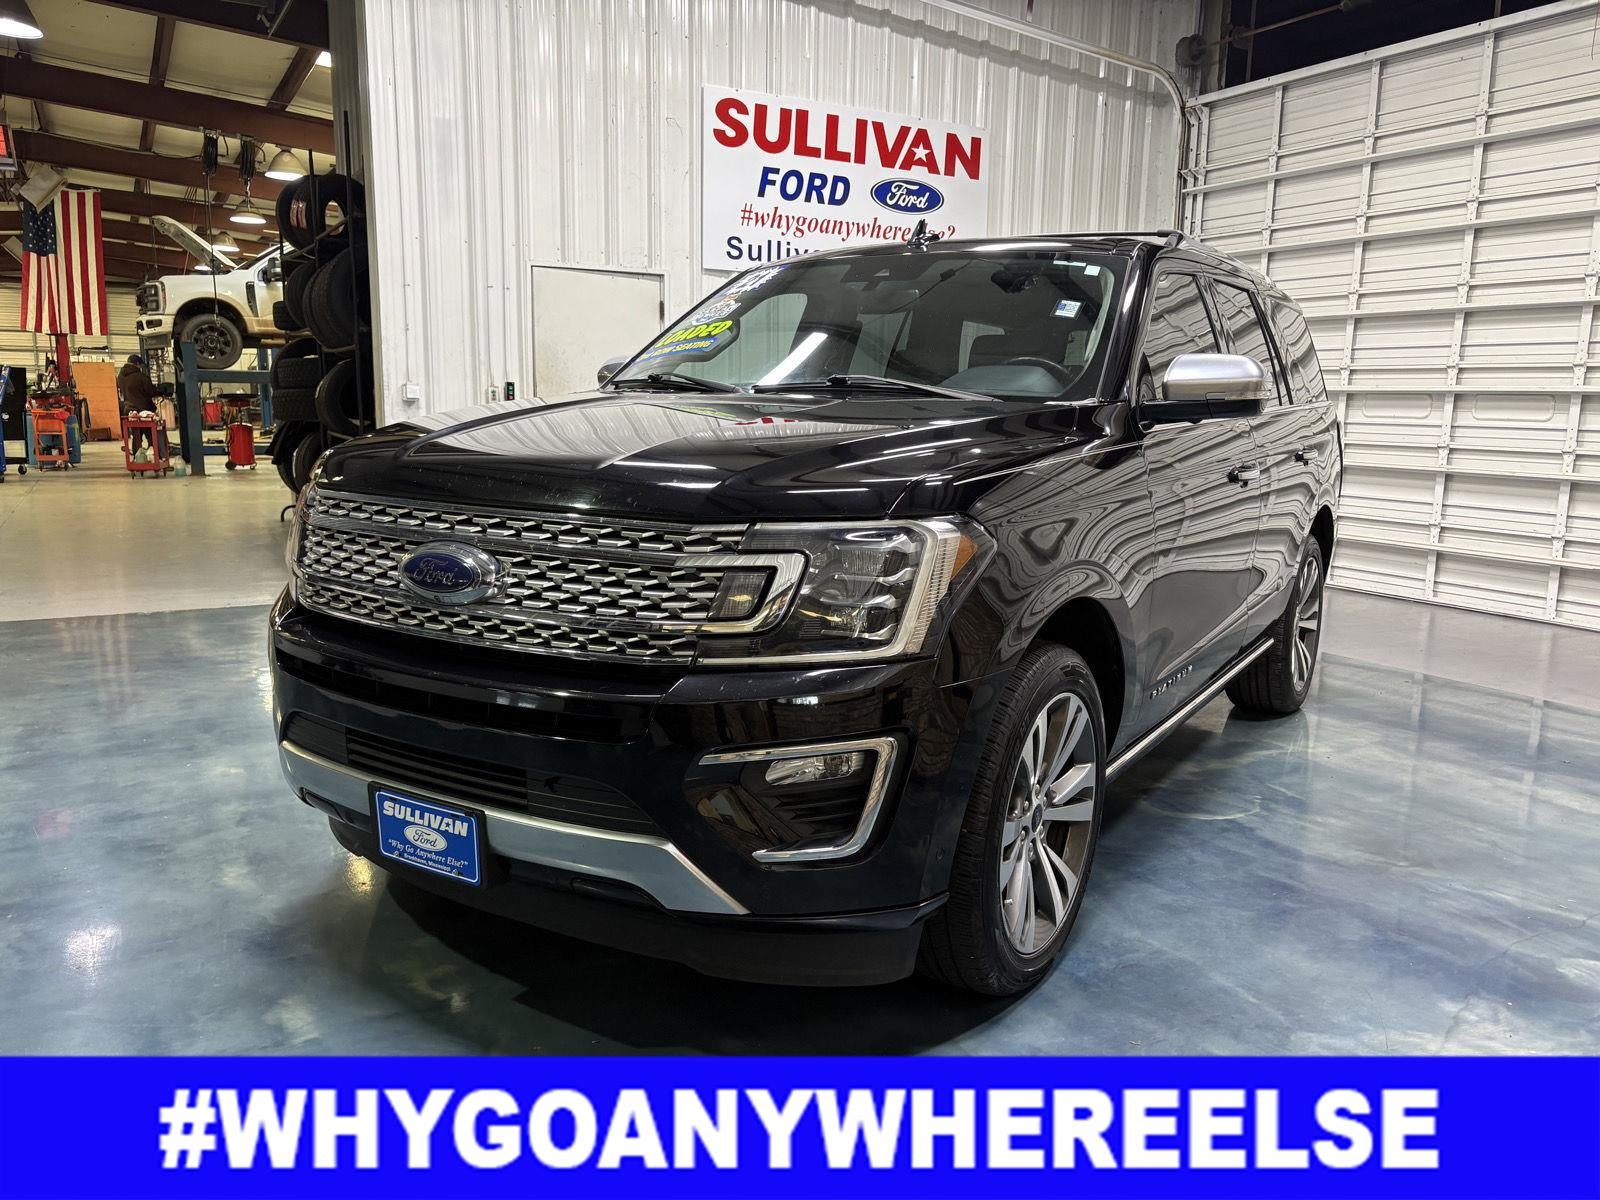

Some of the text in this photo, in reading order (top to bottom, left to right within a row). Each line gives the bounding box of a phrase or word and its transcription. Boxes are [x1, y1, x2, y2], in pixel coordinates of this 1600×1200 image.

[713, 97, 982, 180] SULLIVAN
[757, 166, 850, 206] FORD
[886, 181, 930, 209] Ford
[413, 557, 459, 586] Ford
[382, 800, 469, 837] SULLIVAN
[412, 829, 438, 848] Ford
[415, 847, 446, 863] Anywhere
